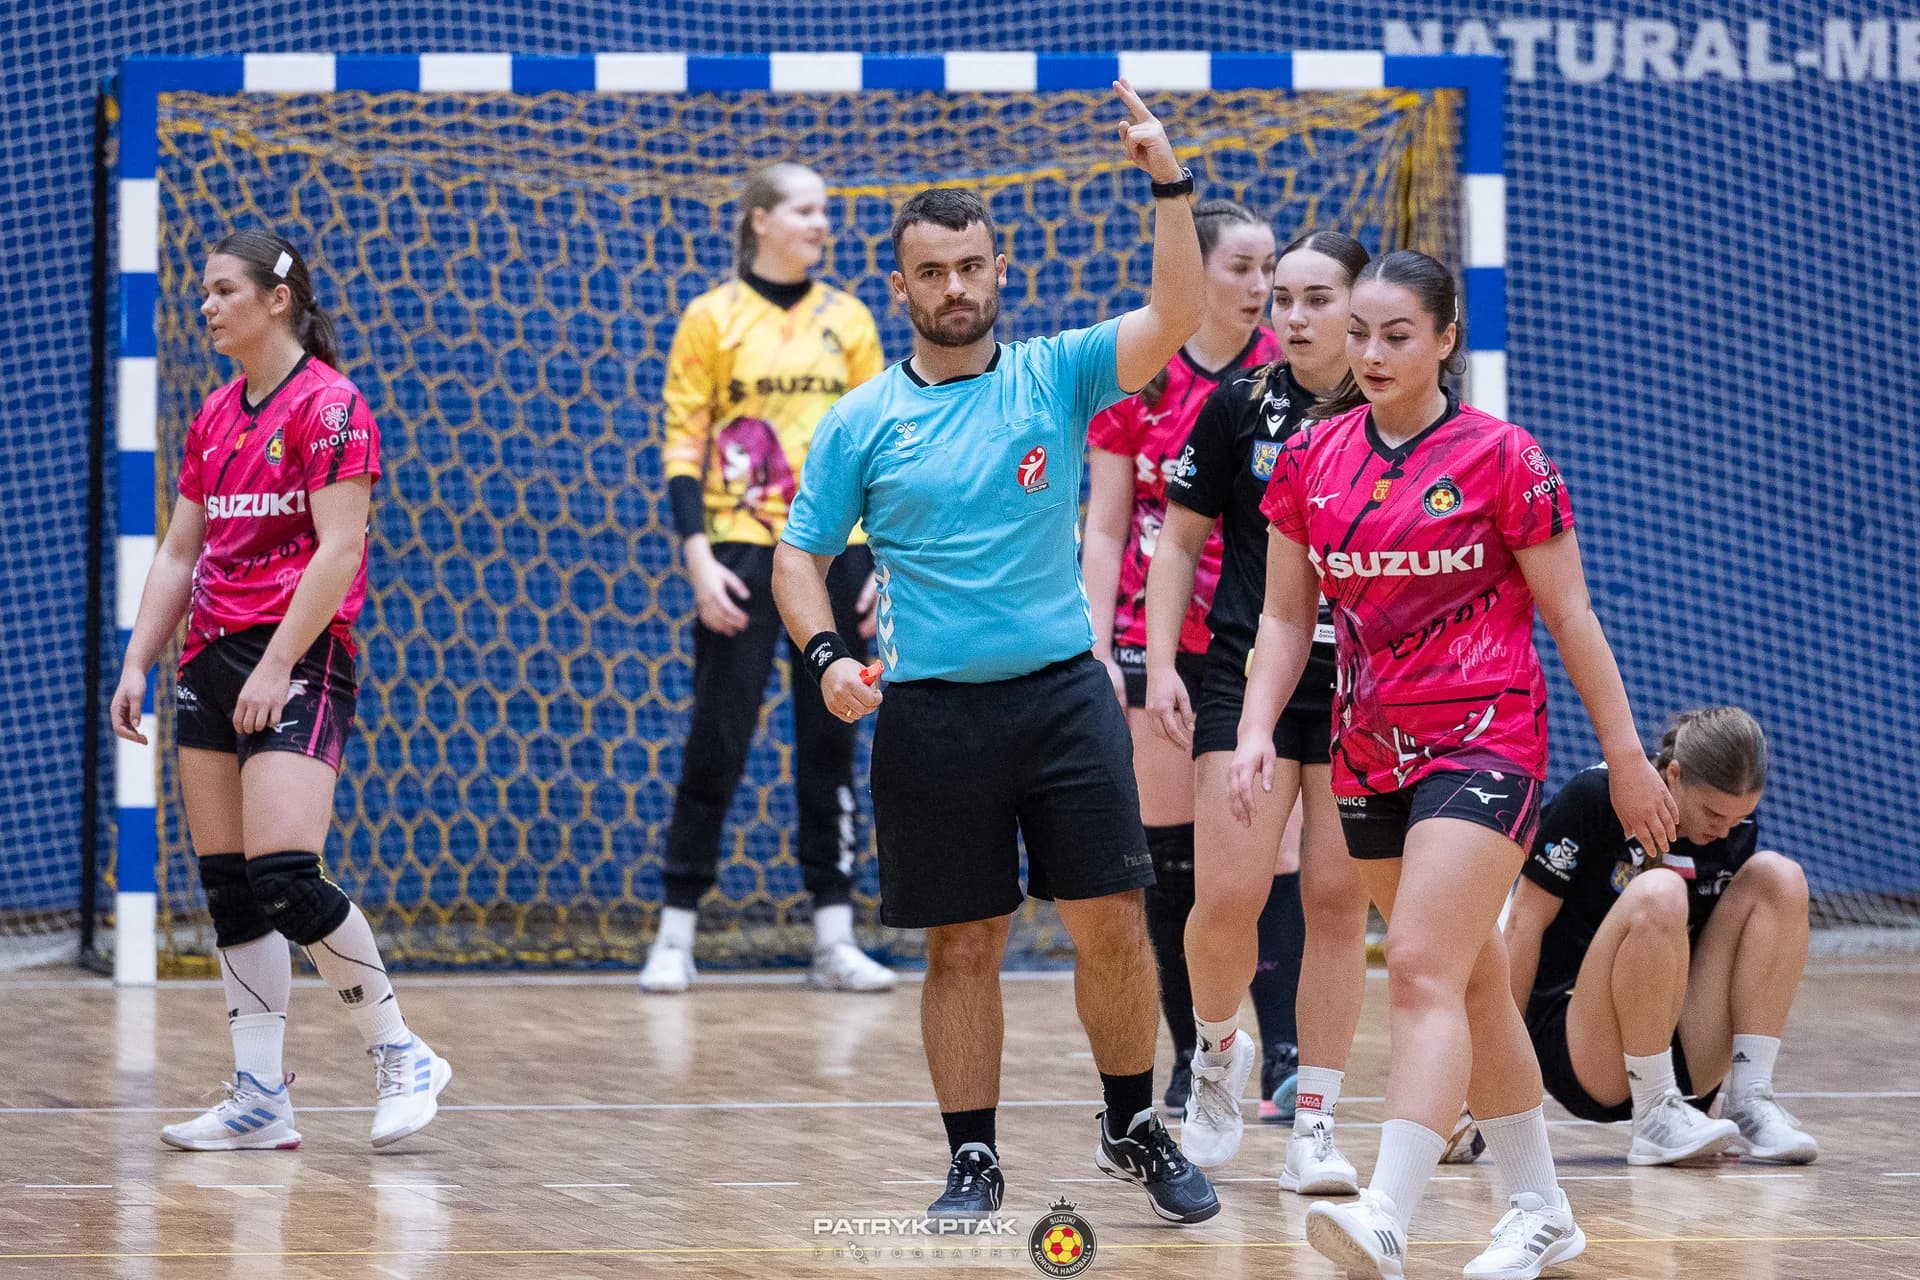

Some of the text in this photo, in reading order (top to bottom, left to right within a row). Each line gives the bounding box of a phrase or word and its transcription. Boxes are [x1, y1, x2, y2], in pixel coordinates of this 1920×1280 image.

[310, 429, 369, 454] PROFIKA
[207, 490, 306, 520] SUZUKI
[1326, 543, 1484, 579] SUZUKI
